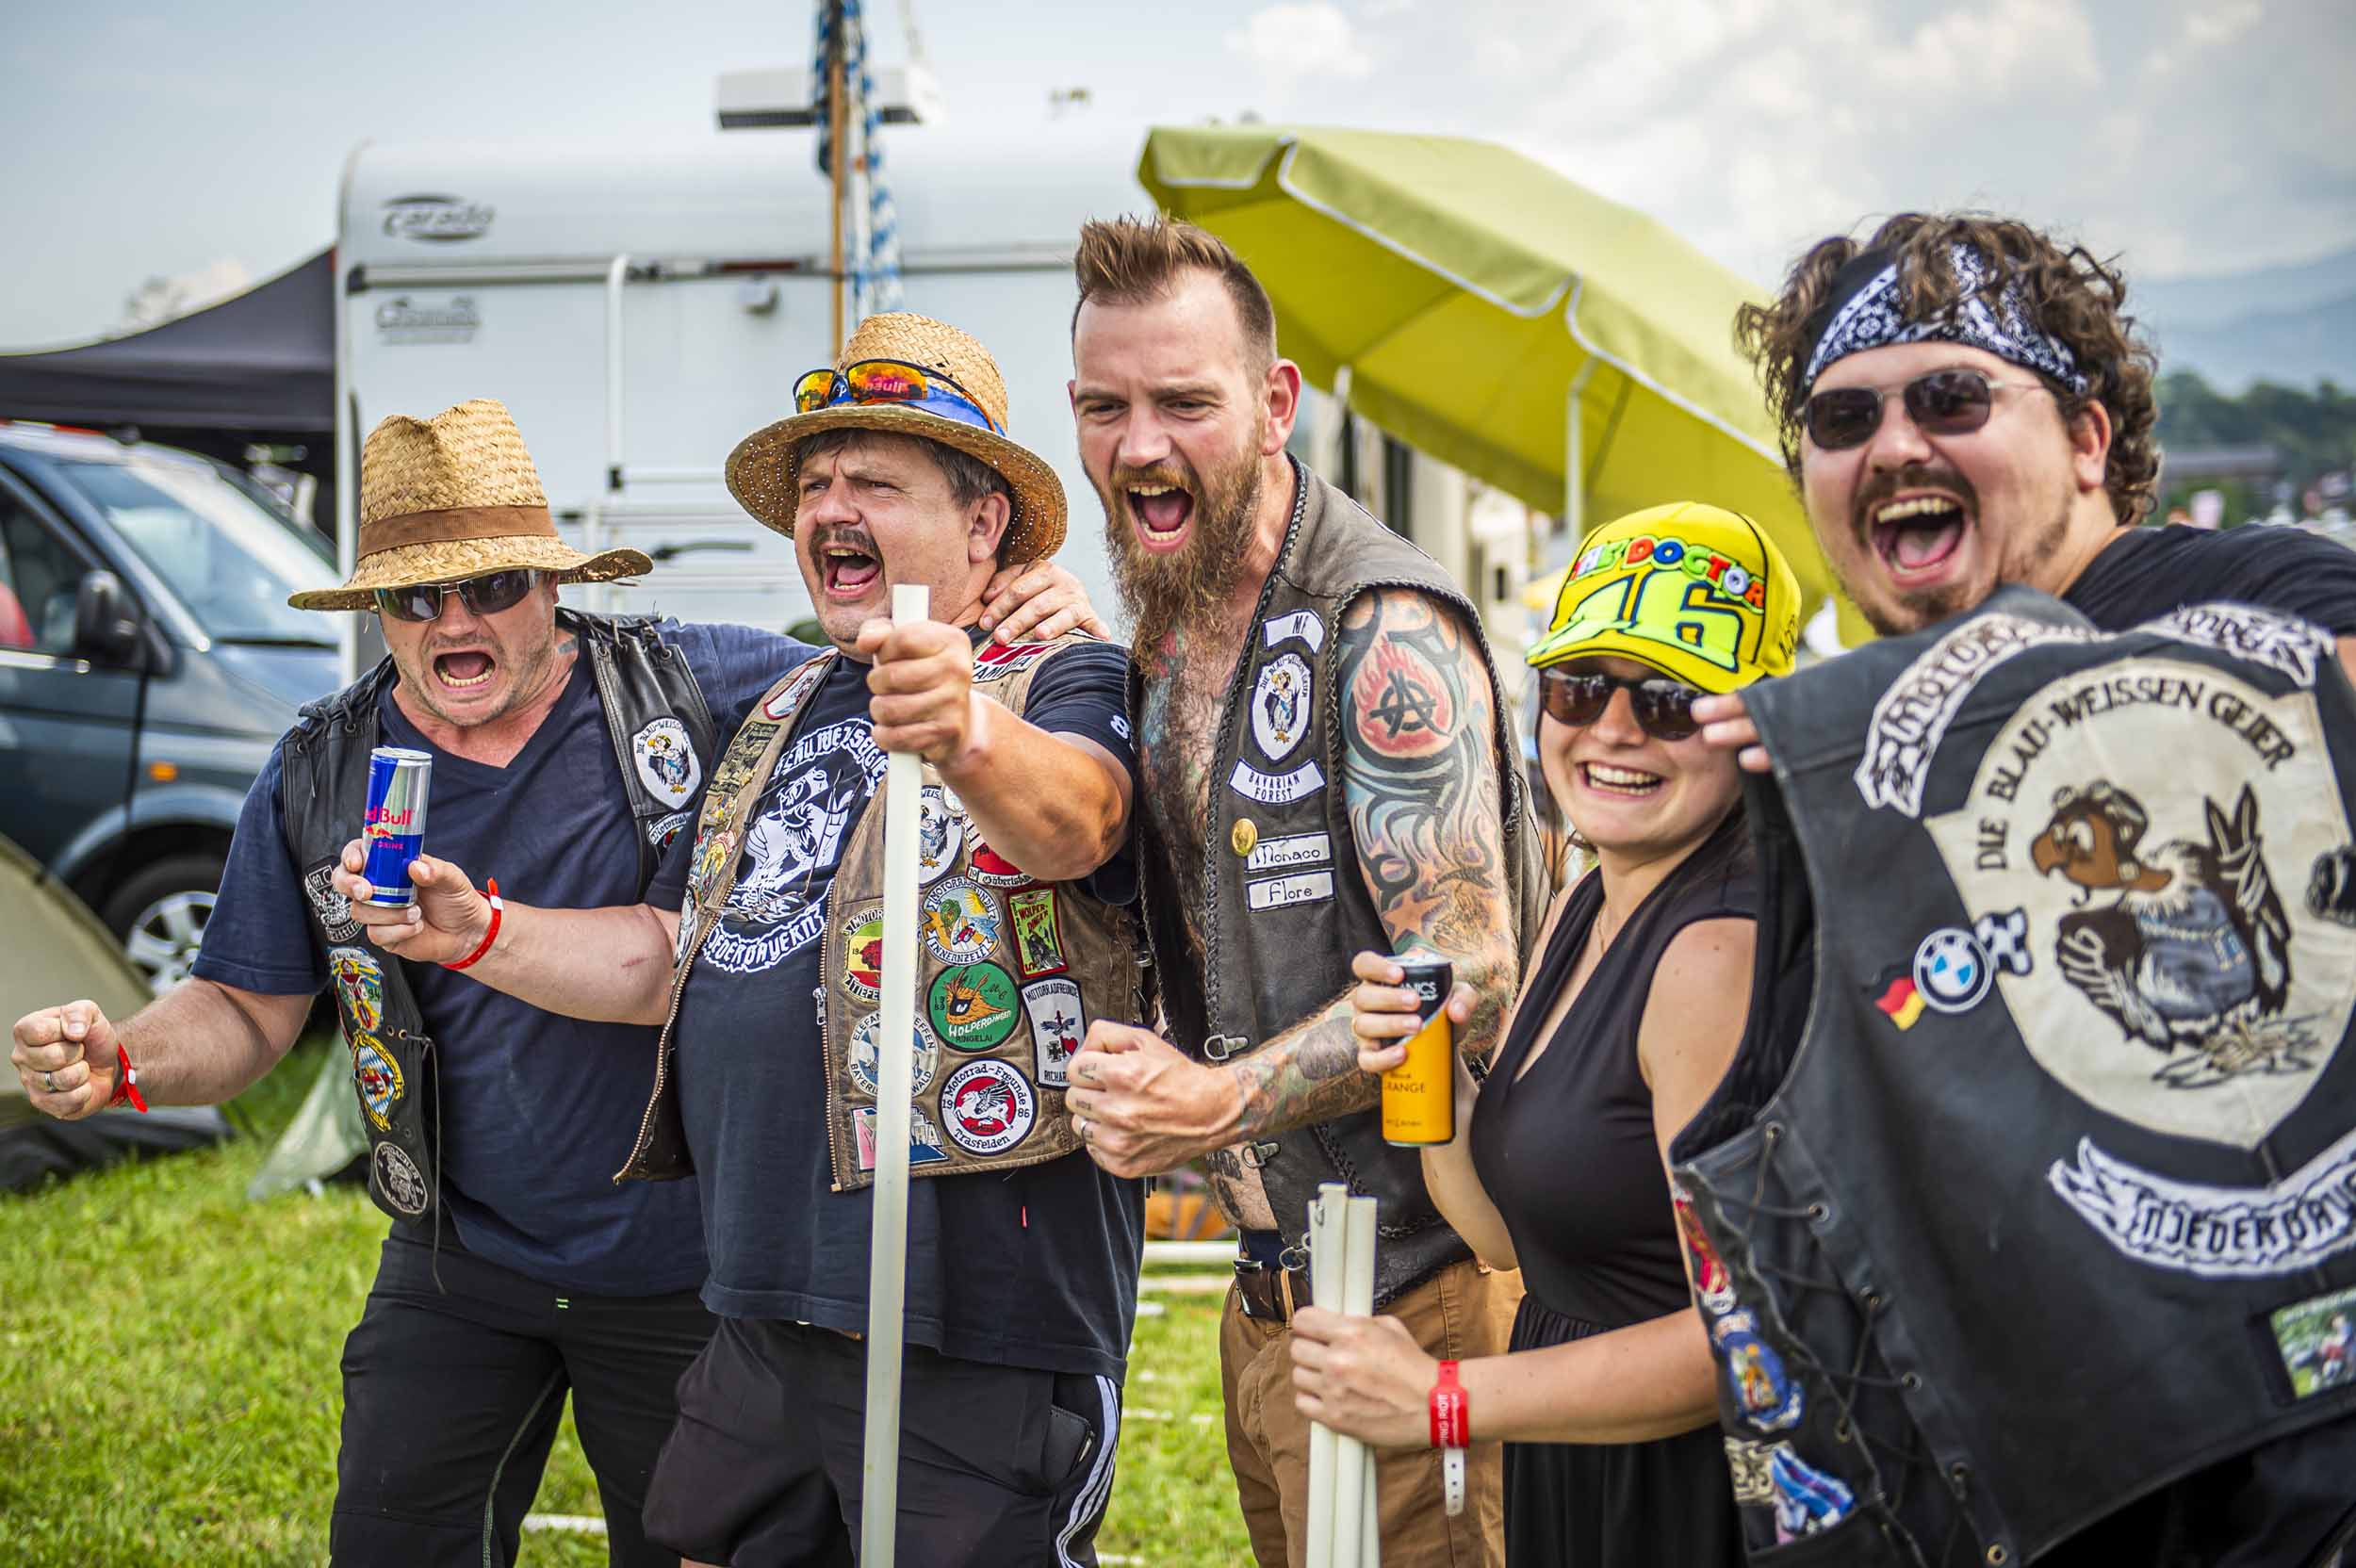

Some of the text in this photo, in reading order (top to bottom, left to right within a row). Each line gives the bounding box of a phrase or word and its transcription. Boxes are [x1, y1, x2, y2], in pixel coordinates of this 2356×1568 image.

[1626, 537, 1766, 609] DOCTOR
[1248, 771, 1301, 790] BAVARIAN
[1977, 816, 2009, 871] DIE
[2207, 691, 2297, 772] GEIER
[1254, 788, 1294, 801] FOREST
[379, 808, 413, 826] Bull
[1255, 844, 1321, 867] Monaco
[1268, 880, 1314, 904] Flore
[852, 909, 883, 929] MOTOR
[850, 980, 881, 1002] TIEFE
[911, 1070, 932, 1093] WALD
[1044, 1070, 1069, 1083] RICHAR
[942, 1099, 1030, 1119] 19 86
[954, 1127, 1011, 1150] Trasfelden
